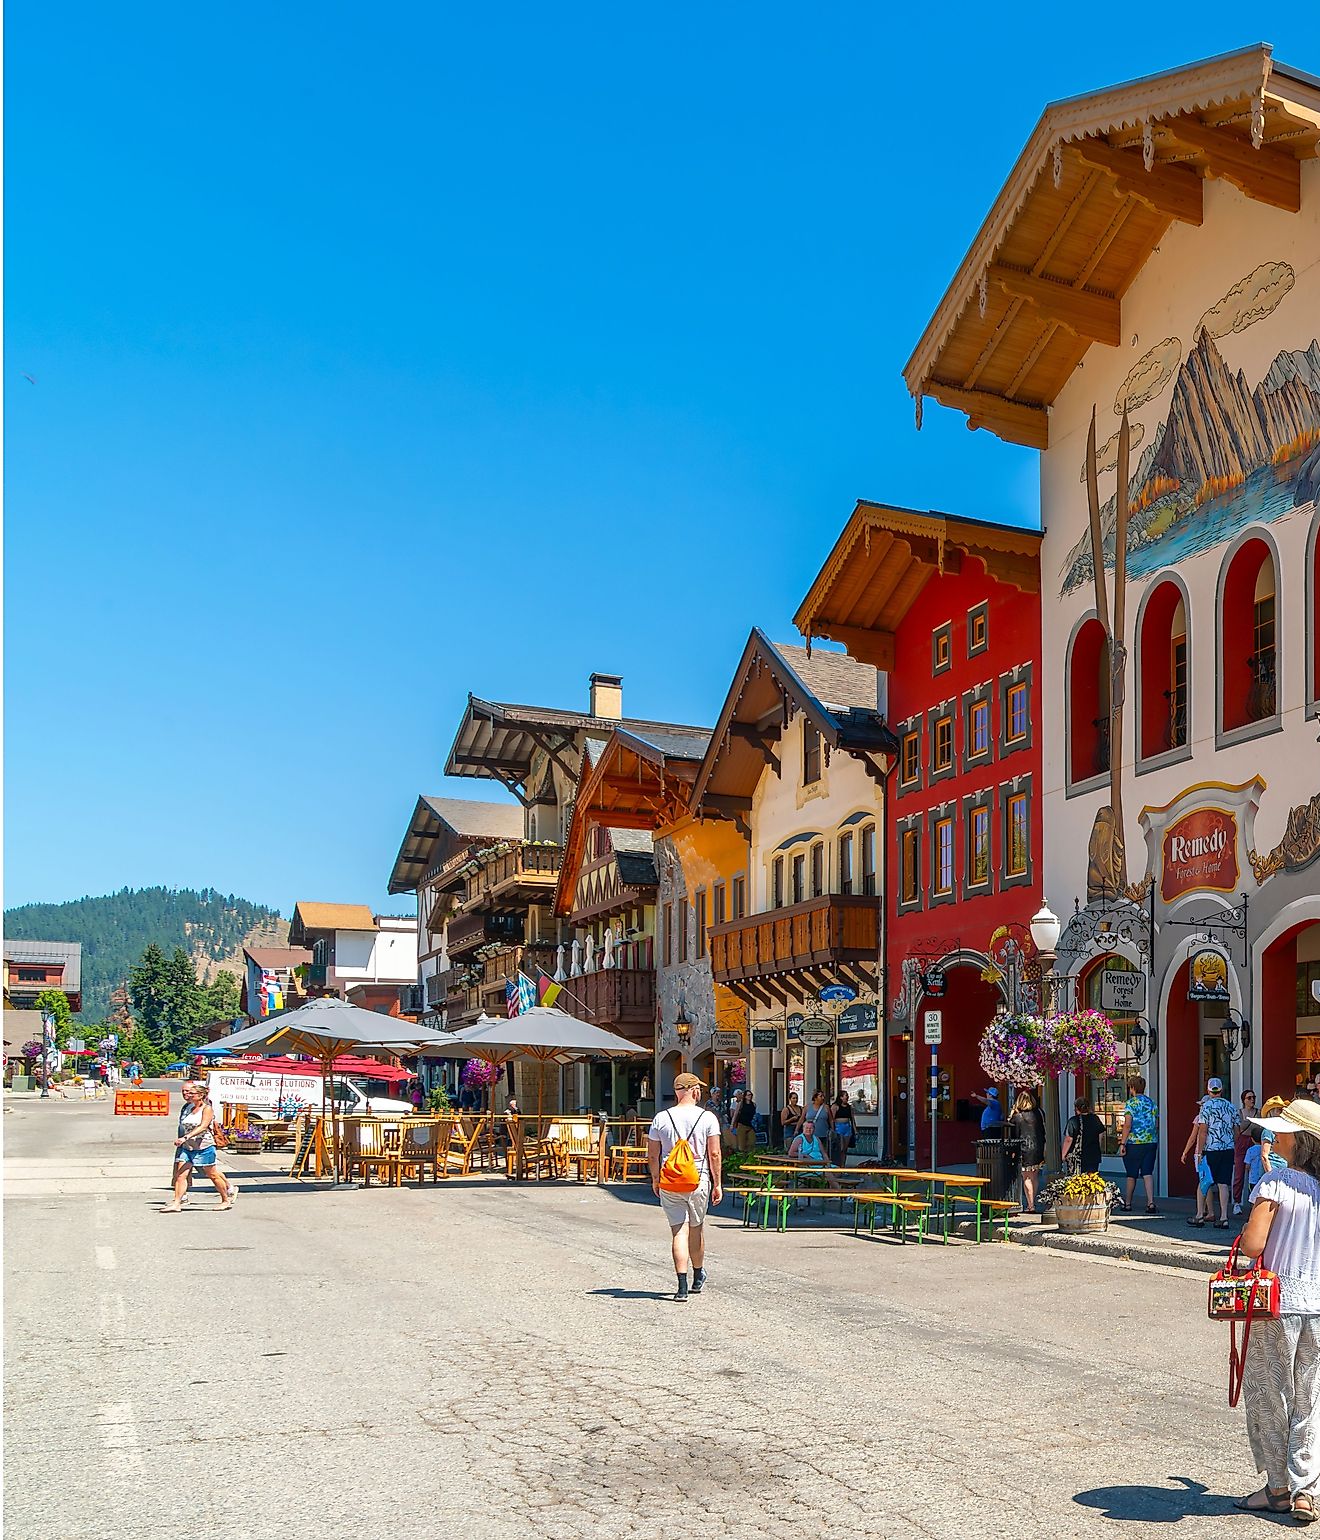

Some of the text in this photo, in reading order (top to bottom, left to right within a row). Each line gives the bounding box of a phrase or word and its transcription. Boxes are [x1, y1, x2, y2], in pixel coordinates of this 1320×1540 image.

[1171, 828, 1227, 863] Remedy
[1203, 860, 1222, 875] Home
[1105, 972, 1141, 988] Remedy
[1113, 985, 1134, 995] Forest
[1114, 999, 1133, 1008] Home
[928, 1014, 938, 1022] 30
[220, 1078, 254, 1087] CENTRA
[259, 1079, 272, 1087] AIR
